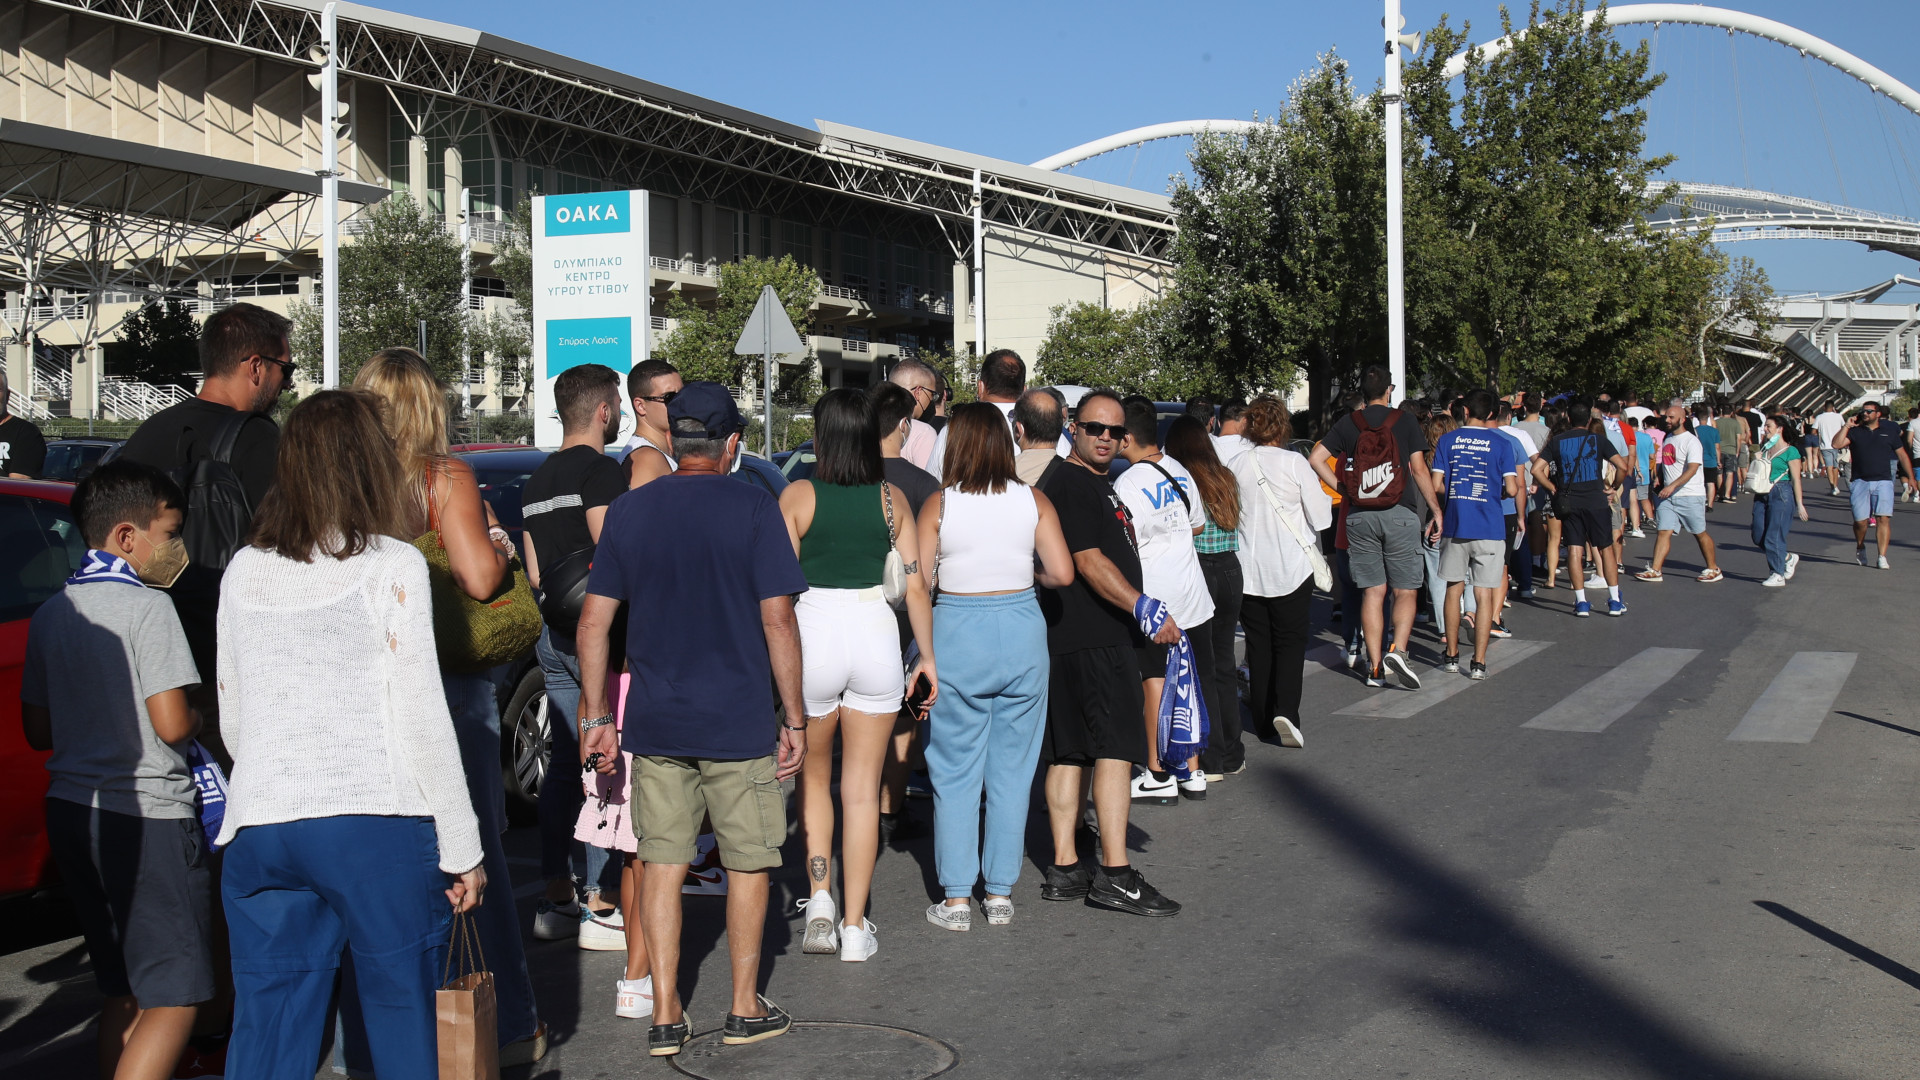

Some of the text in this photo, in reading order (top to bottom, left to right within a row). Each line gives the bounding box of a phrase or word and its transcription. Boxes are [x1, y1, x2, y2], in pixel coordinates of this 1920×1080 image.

[556, 204, 619, 224] ΟΑΚΑ
[553, 256, 622, 269] ΟΛΥΜΠΙΑΚΟ
[565, 271, 610, 282] ΚΕΝΤΡΟ
[547, 284, 629, 296] ΥΓΡΟΥ ΣΤΙΒΟΥ
[558, 336, 618, 346] Σπύρος Λούης
[1362, 461, 1394, 491] NIKE
[617, 996, 634, 1008] IKE
